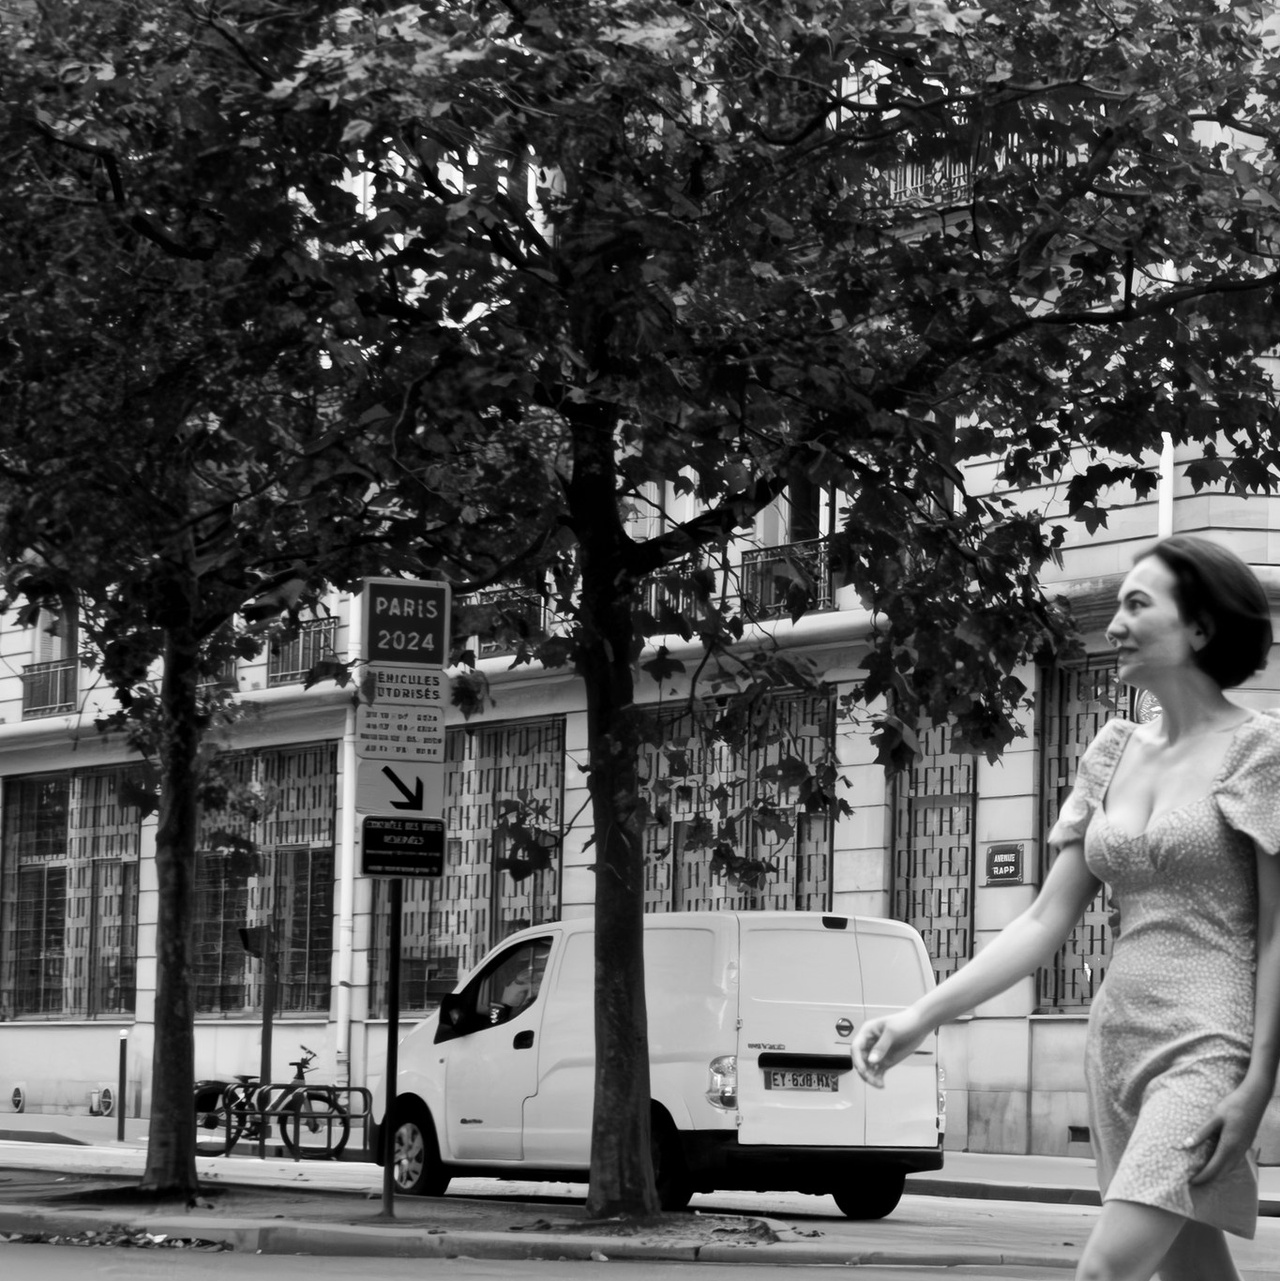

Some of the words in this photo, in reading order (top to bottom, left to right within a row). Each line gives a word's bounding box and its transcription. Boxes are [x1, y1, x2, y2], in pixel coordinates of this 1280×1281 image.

[377, 630, 435, 651] 2024
[377, 671, 440, 687] ÉHICULES
[993, 866, 1015, 875] RAPP
